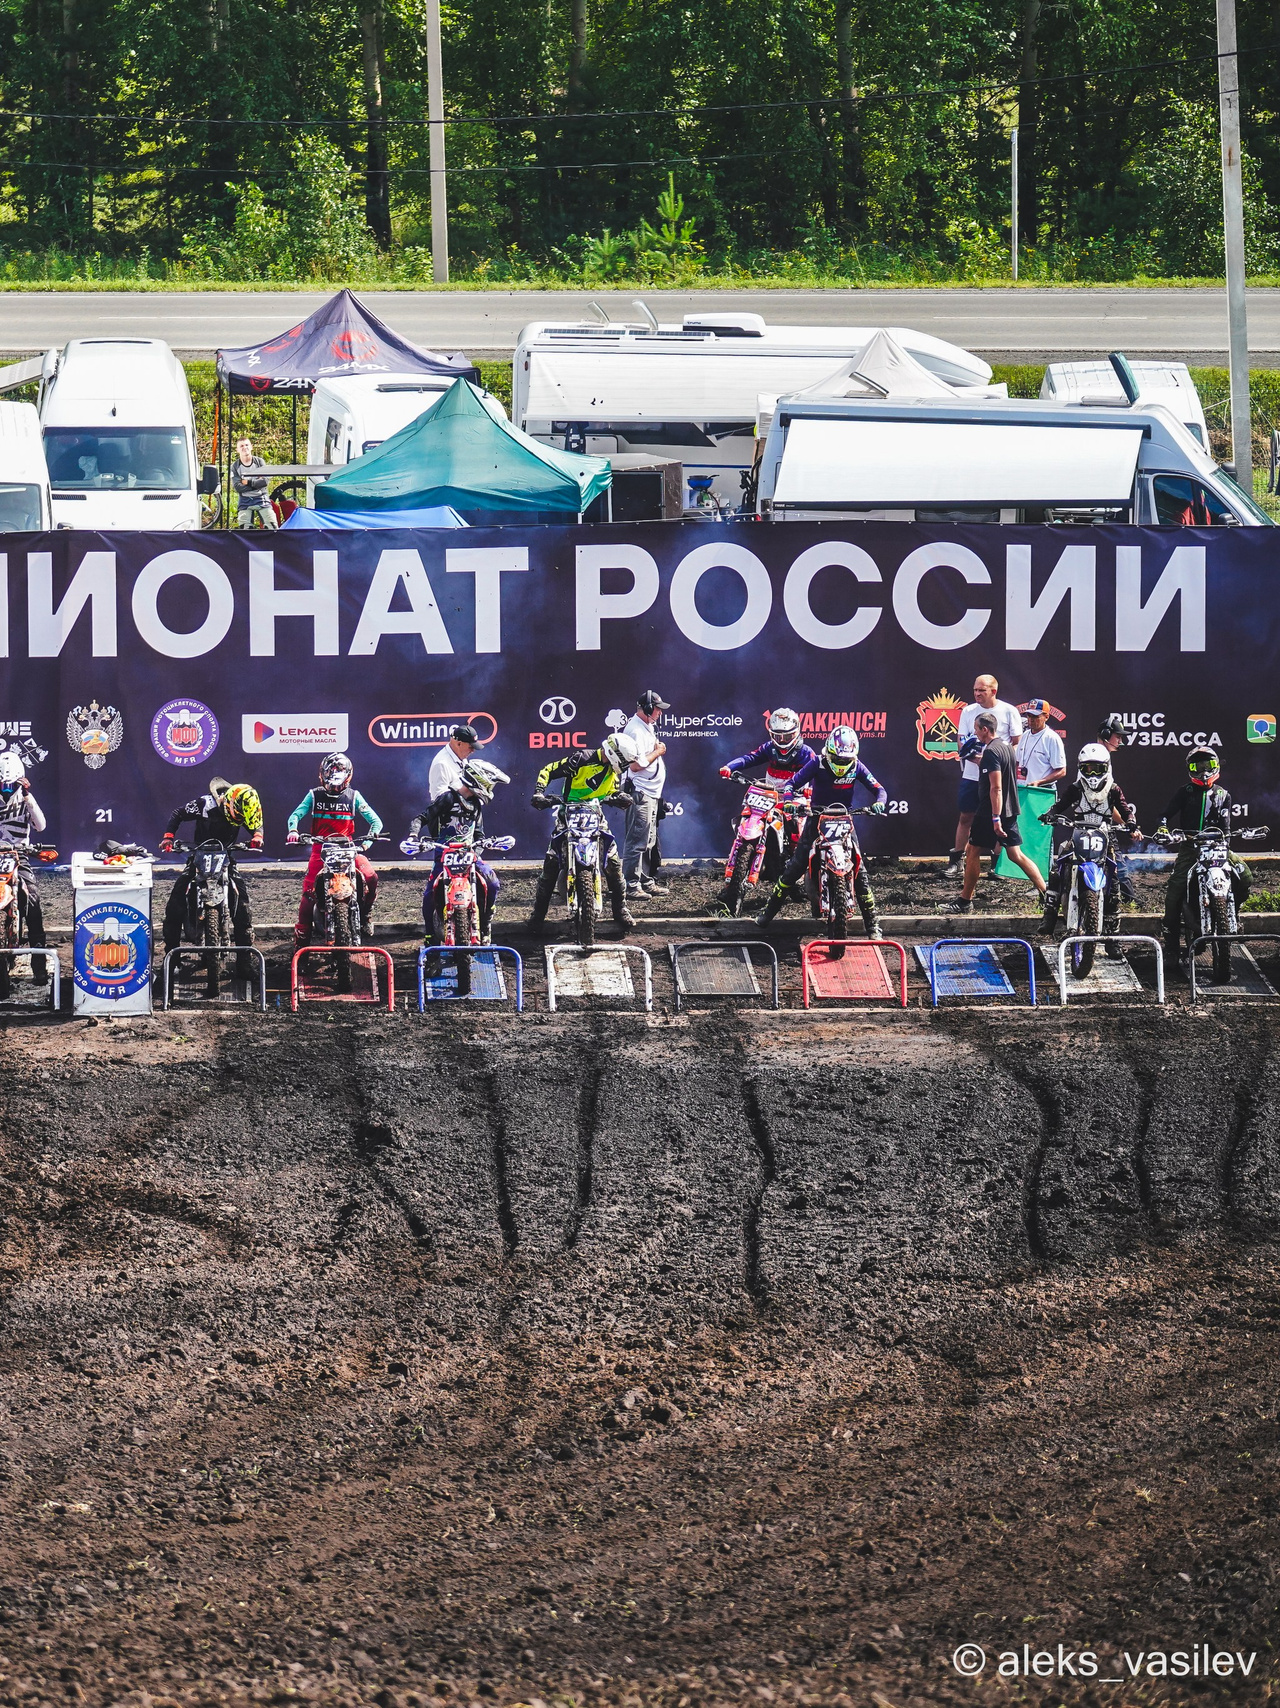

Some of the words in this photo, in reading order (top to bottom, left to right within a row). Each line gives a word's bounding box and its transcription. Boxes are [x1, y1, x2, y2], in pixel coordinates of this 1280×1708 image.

[576, 541, 1206, 652] РОССИИ
[664, 714, 743, 728] HyperScale
[529, 731, 587, 749] BAIC
[859, 731, 886, 739] yms.ru
[1119, 731, 1223, 746] УЗБАССА
[174, 756, 197, 764] MFR
[888, 800, 909, 814] 28
[1231, 803, 1249, 817] 31
[95, 808, 113, 822] 21
[1080, 836, 1104, 851] 16
[203, 853, 227, 873] 17
[75, 906, 139, 934] ОТОЦИКЛЕТНОГО
[93, 943, 129, 967] МФР
[96, 985, 126, 996] MFR
